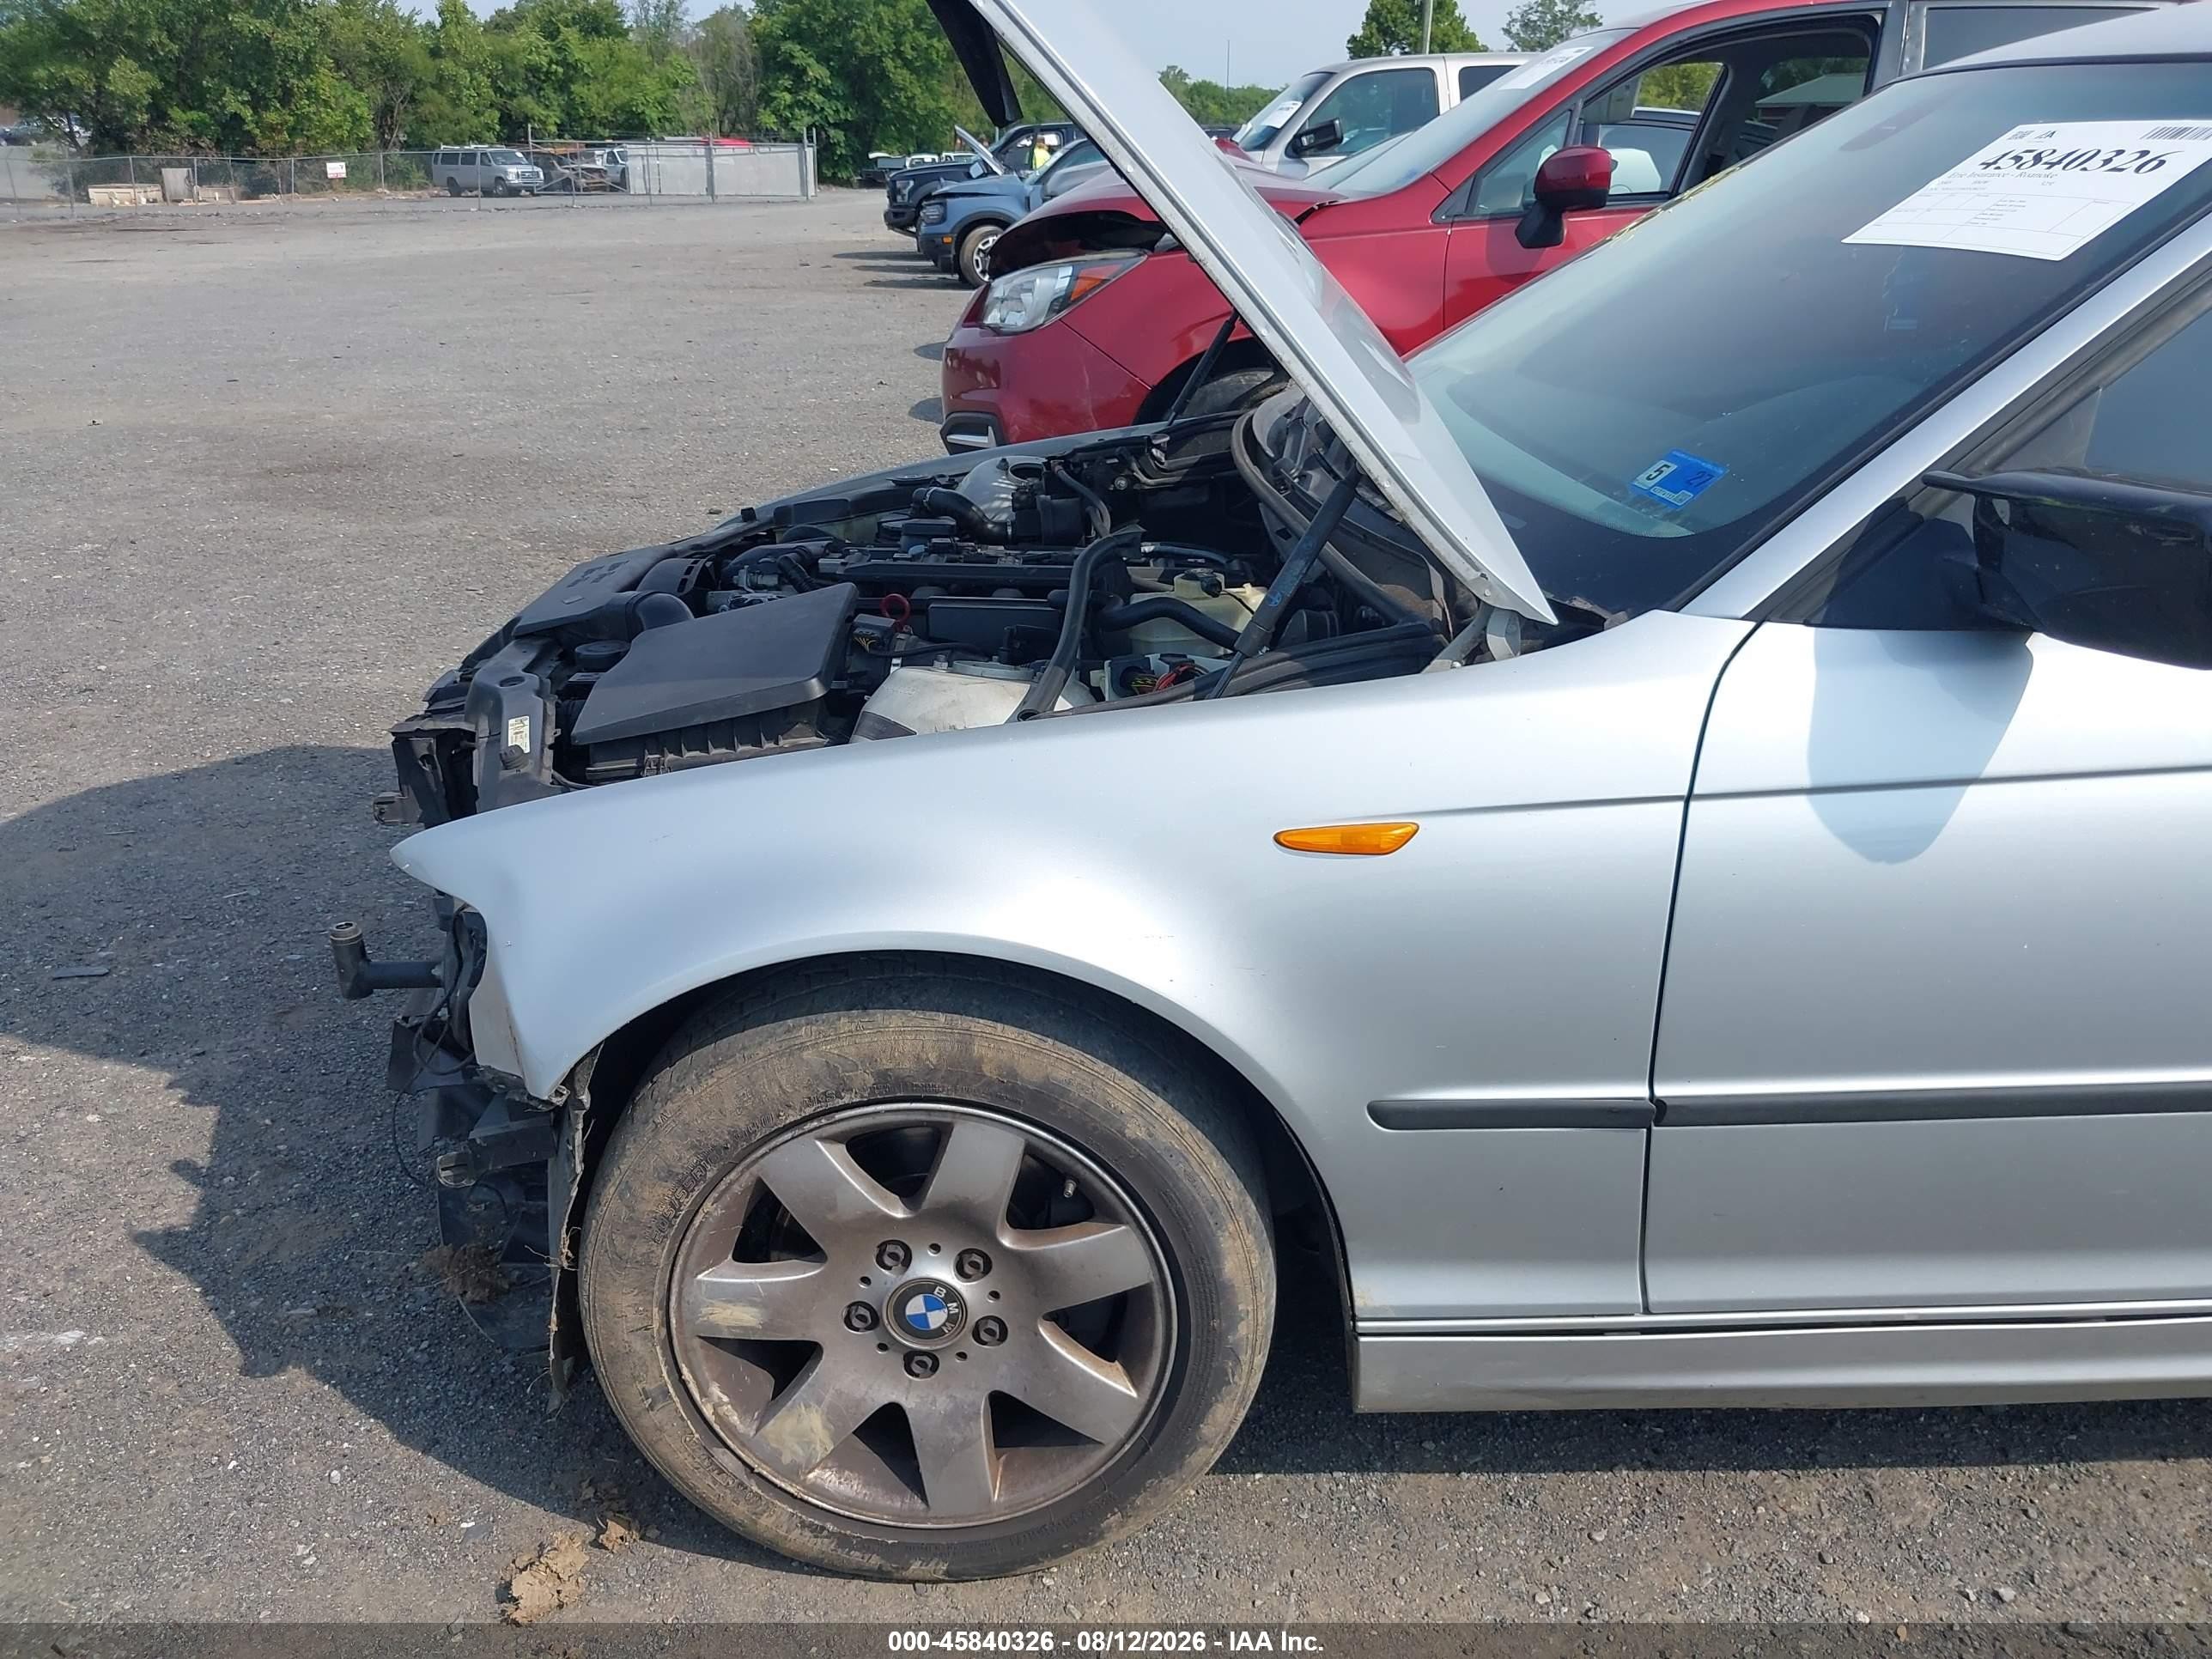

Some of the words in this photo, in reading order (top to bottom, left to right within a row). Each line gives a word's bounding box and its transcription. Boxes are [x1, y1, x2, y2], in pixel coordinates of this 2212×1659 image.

[1978, 149, 2184, 174] 45840326
[1645, 464, 1672, 482] 5
[933, 1285, 960, 1334] BMW
